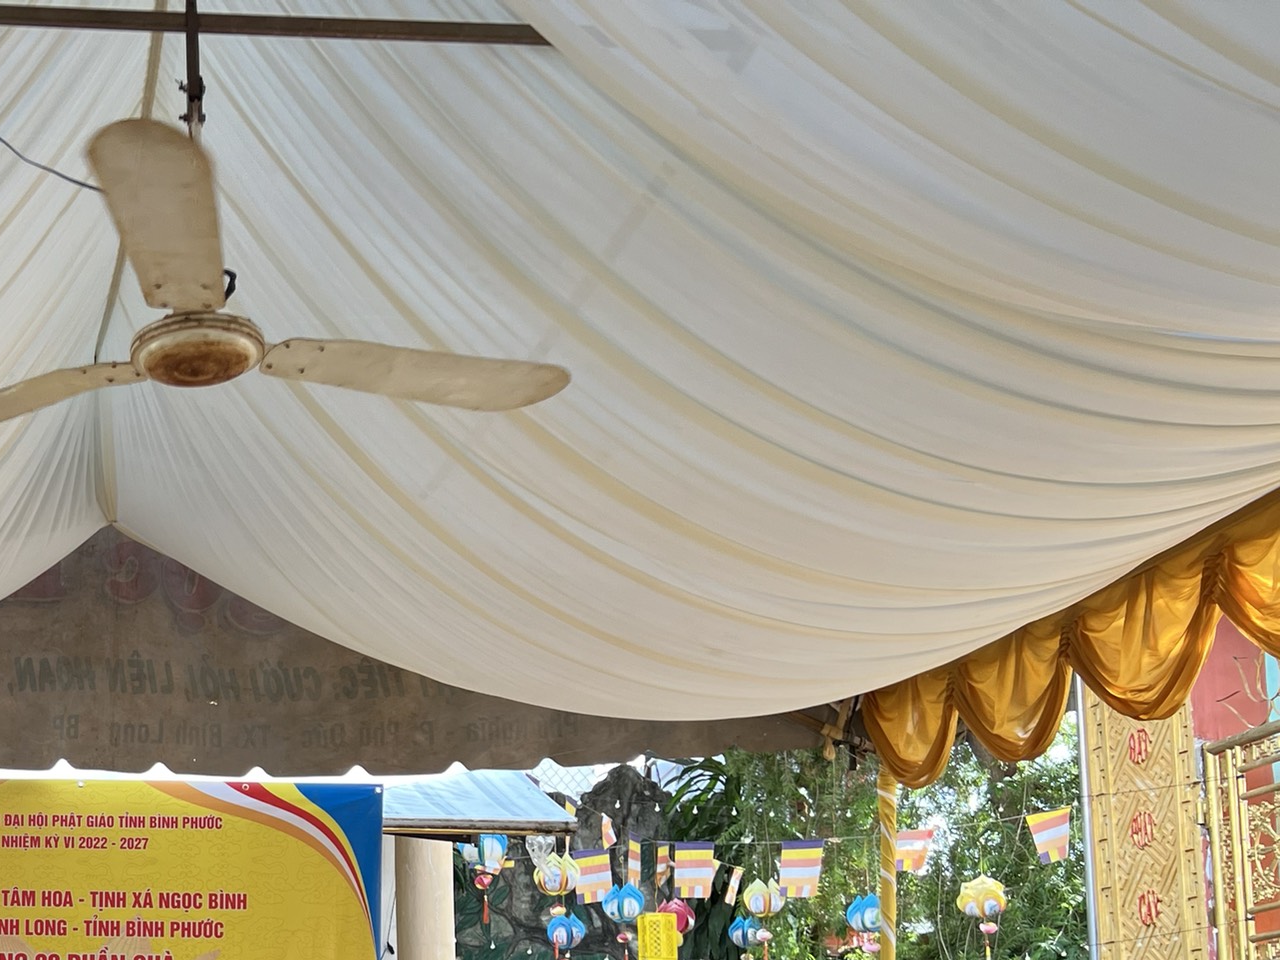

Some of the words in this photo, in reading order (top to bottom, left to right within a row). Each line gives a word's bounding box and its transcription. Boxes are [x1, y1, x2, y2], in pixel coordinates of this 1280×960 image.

[4, 813, 24, 829] ĐẠI
[28, 812, 48, 829] HỘI
[52, 812, 82, 830] PHẬT
[86, 812, 114, 828] GIÁO
[118, 812, 145, 828] TỈNH
[149, 813, 178, 829] BÌNH
[182, 814, 222, 829] PHƯỚC
[1, 833, 40, 850] NHIỆM
[45, 834, 60, 848] KỲ
[64, 836, 74, 848] VI
[78, 837, 107, 849] 2022
[120, 838, 149, 849] 2027
[2, 887, 36, 907] TÂM
[41, 891, 73, 907] HOA
[90, 891, 126, 911] TỊNH
[132, 889, 154, 908] XÁ
[158, 892, 203, 912] NGỌC
[208, 890, 247, 909] BÌNH
[25, 919, 67, 936] LONG
[83, 915, 120, 937] TỈNH
[126, 917, 164, 937] BÌNH
[170, 919, 224, 938] PHƯỚC
